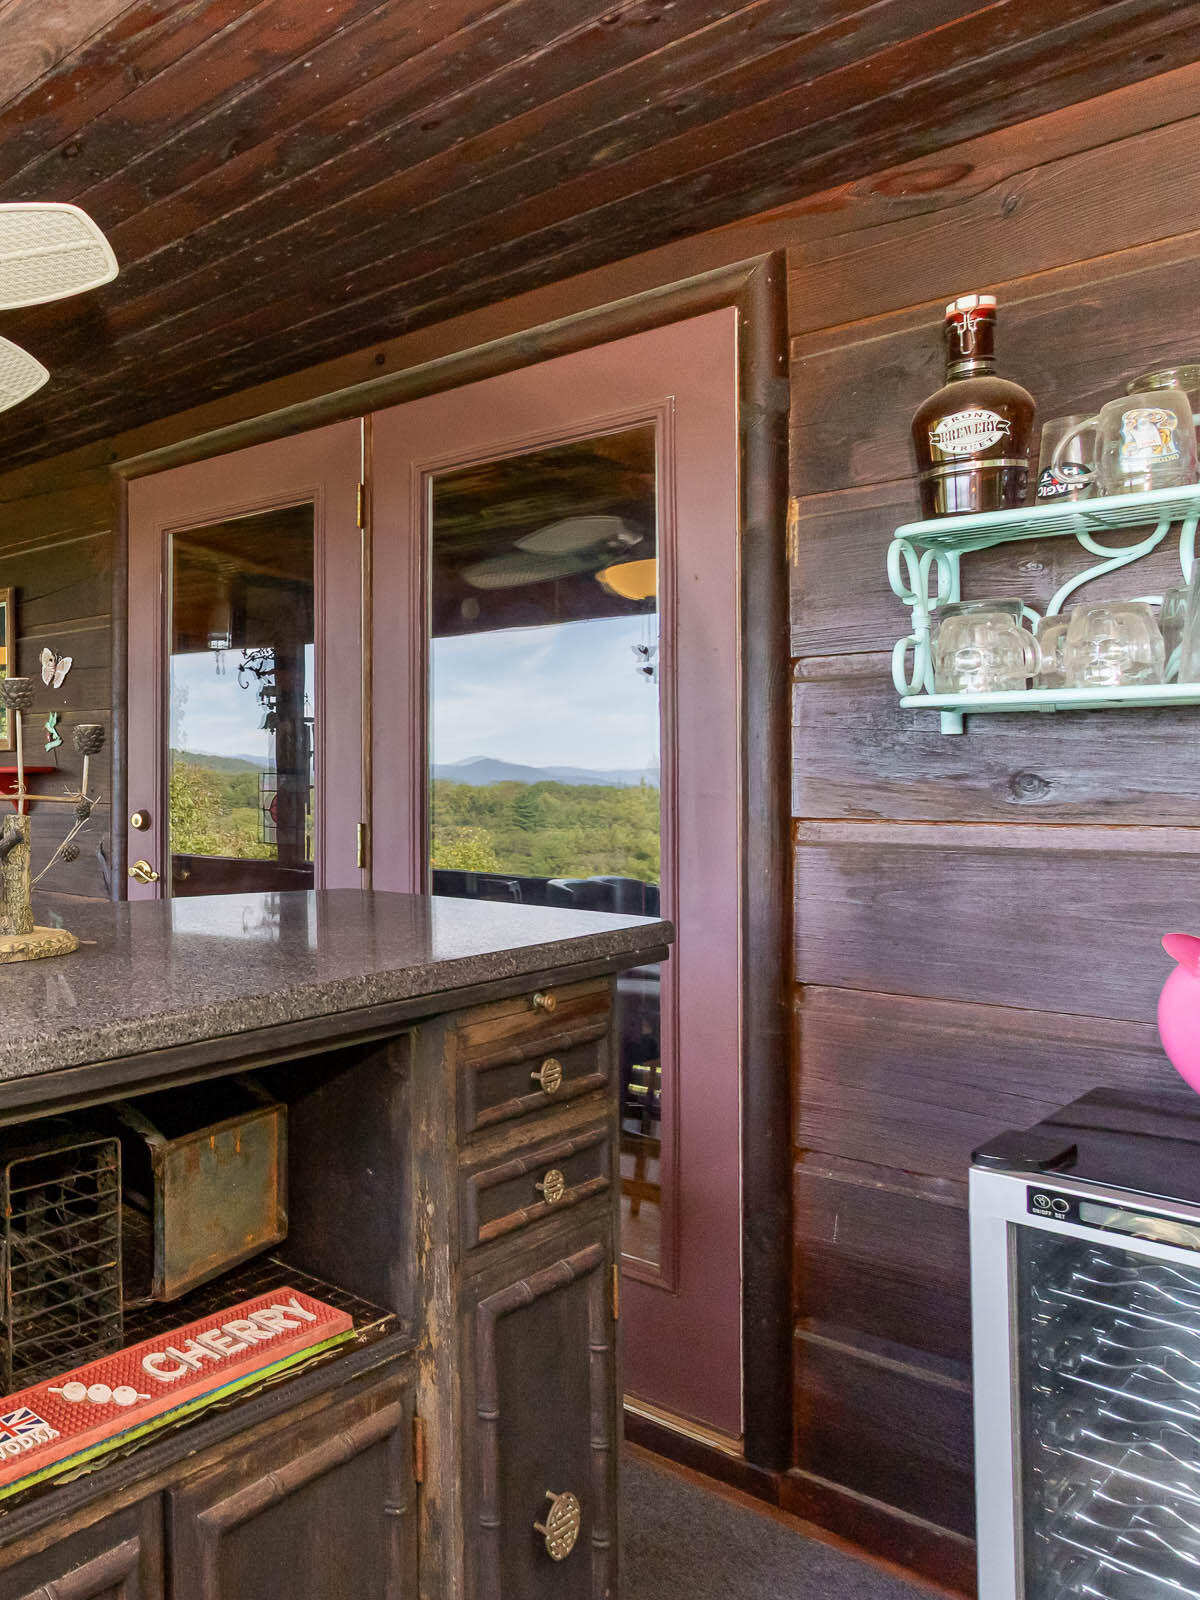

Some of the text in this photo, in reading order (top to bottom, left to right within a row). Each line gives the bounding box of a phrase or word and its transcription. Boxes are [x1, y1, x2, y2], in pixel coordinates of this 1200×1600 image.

[943, 411, 995, 428] FRONT
[940, 419, 997, 443] BREWERY
[944, 436, 994, 451] STREET
[142, 1297, 318, 1382] CHERRY
